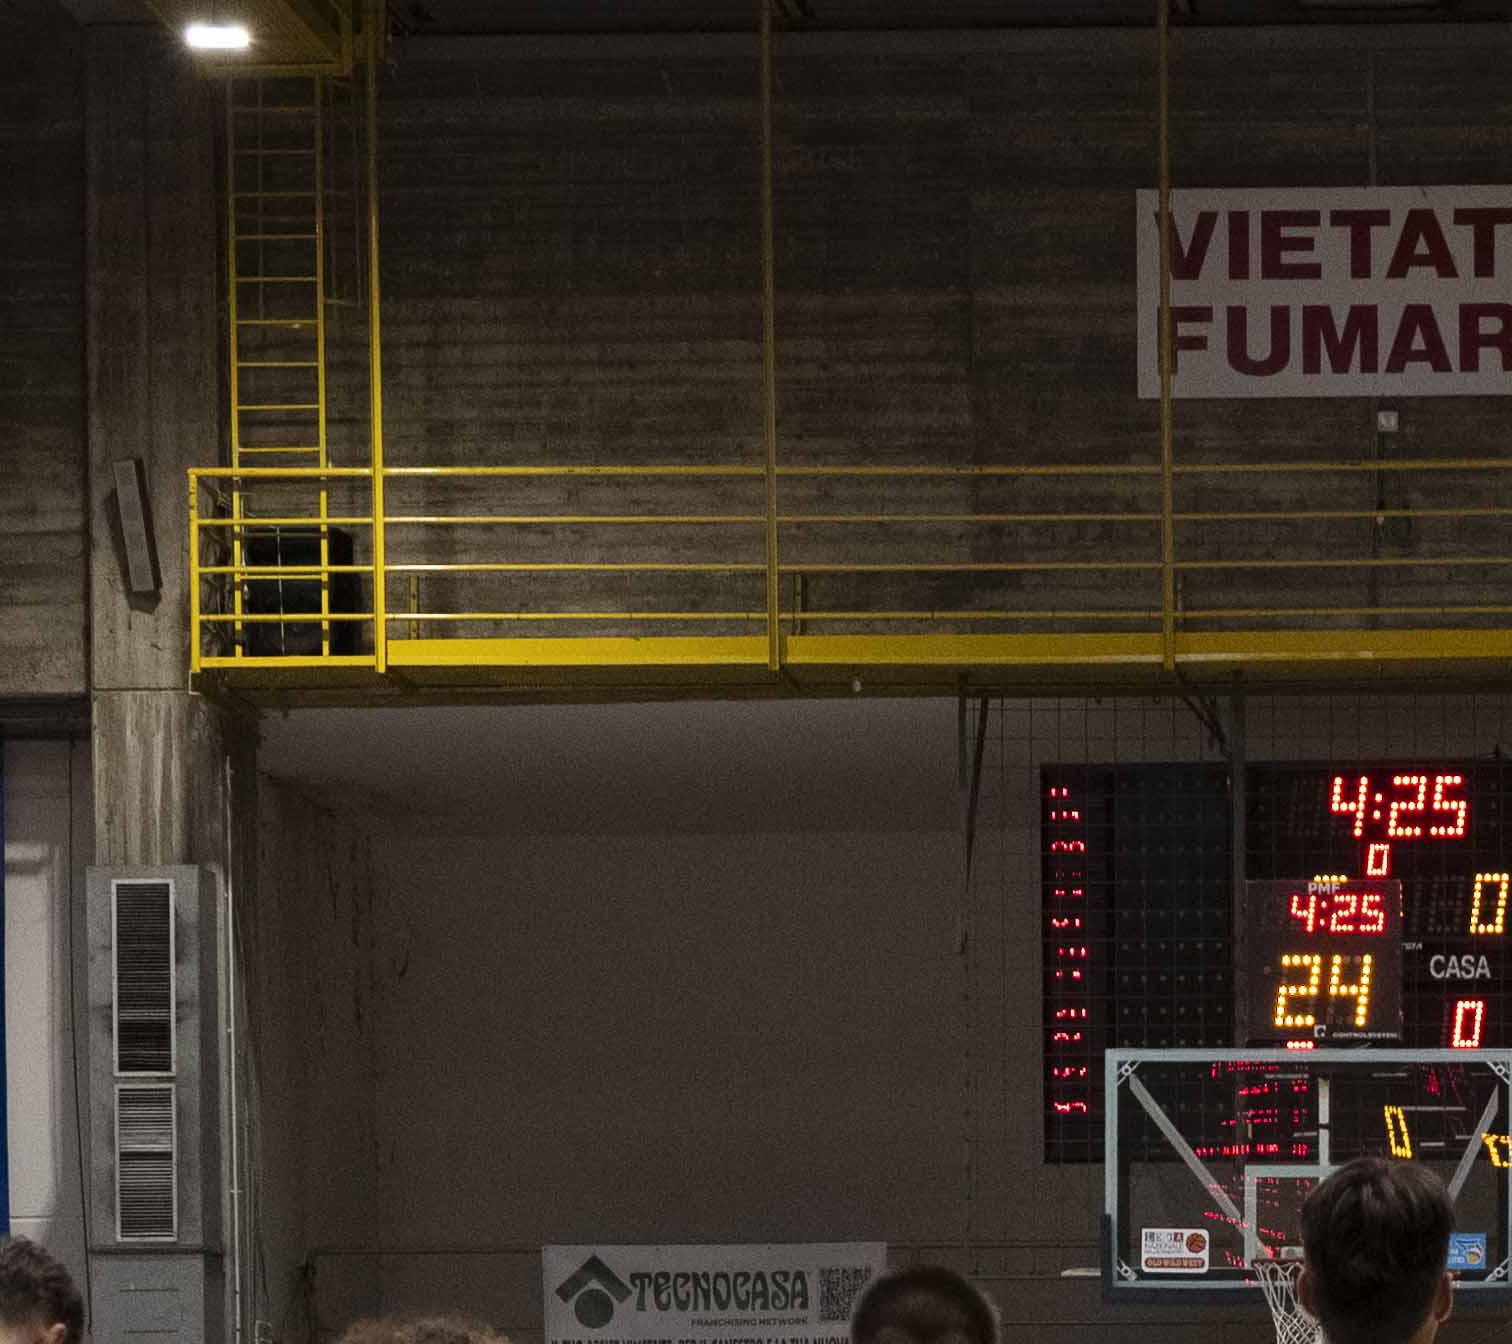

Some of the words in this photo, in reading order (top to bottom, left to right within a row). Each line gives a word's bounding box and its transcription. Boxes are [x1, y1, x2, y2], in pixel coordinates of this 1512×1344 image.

[1330, 774, 1469, 838] 4:25
[1365, 842, 1392, 876] 0
[1289, 893, 1386, 935] 4:25
[1468, 871, 1512, 936] 0
[1428, 953, 1493, 980] CASA
[1273, 952, 1374, 1029] 24
[1449, 997, 1488, 1048] 0
[628, 1270, 809, 1313] TECNOCASA
